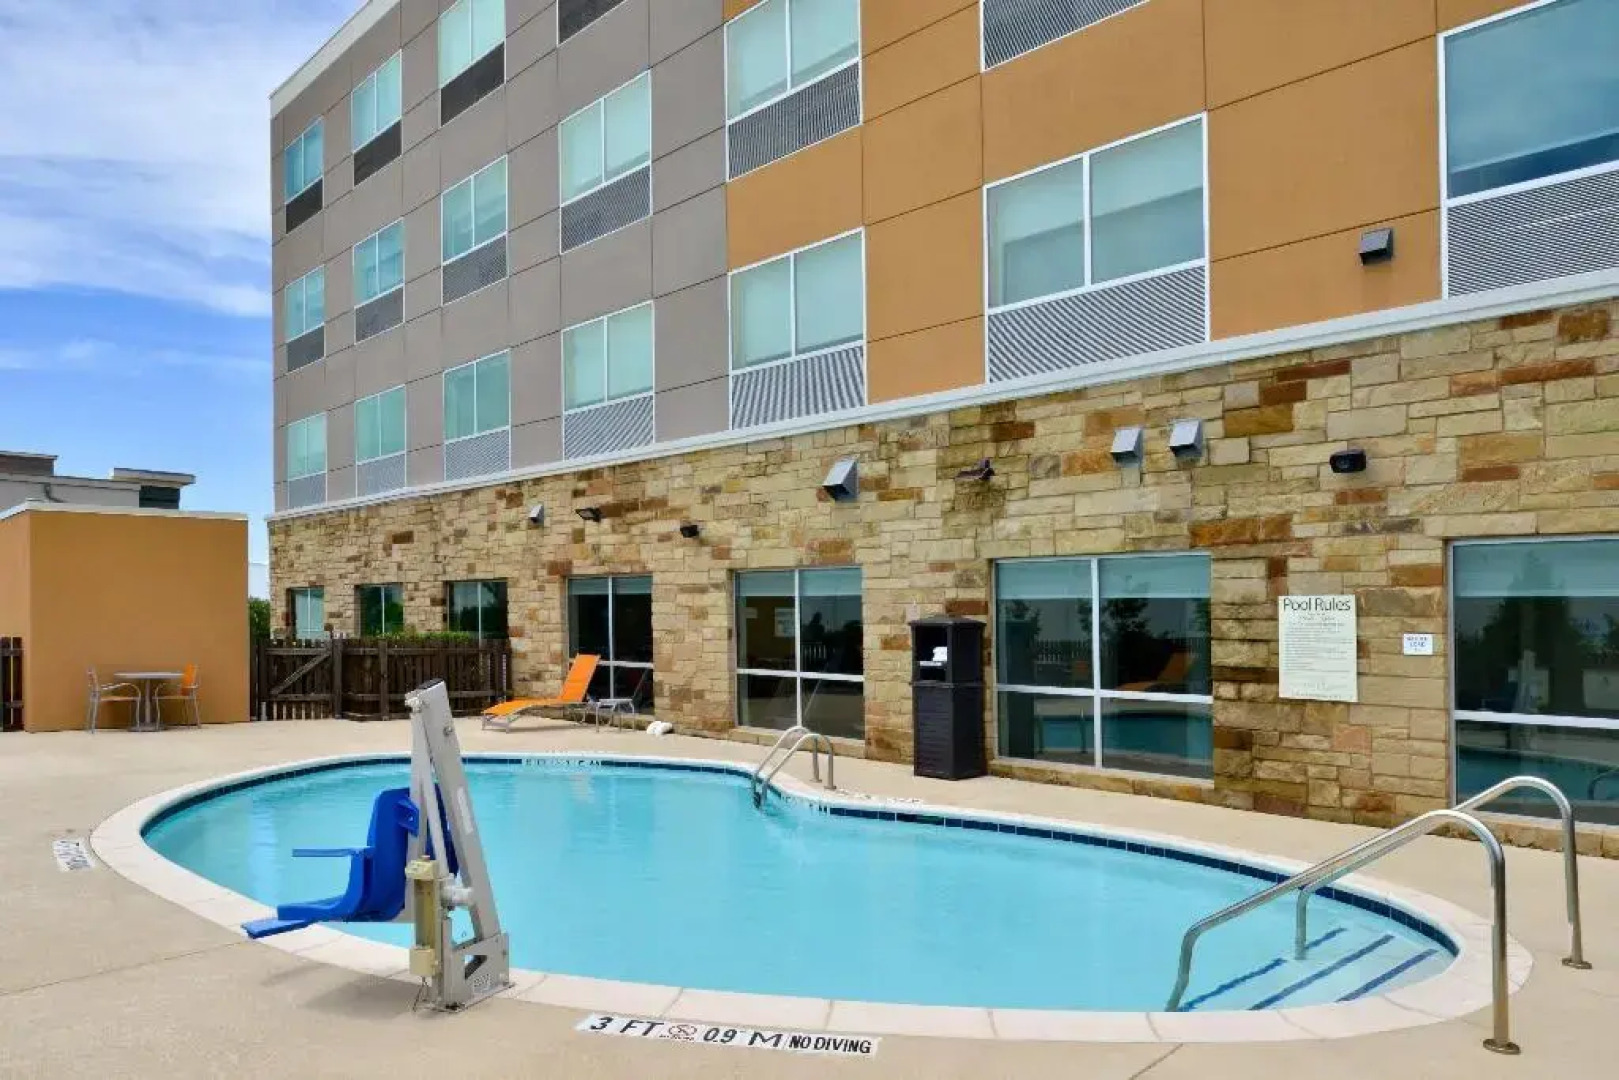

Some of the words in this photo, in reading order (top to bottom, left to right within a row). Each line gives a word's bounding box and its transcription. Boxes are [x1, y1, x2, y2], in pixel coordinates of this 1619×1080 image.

[1283, 597, 1311, 612] Pool
[1315, 597, 1351, 611] Rules
[590, 1016, 614, 1030] 3
[619, 1019, 664, 1036] FT
[748, 1032, 783, 1048] M
[788, 1035, 811, 1049] NO
[813, 1037, 872, 1054] DIVING
